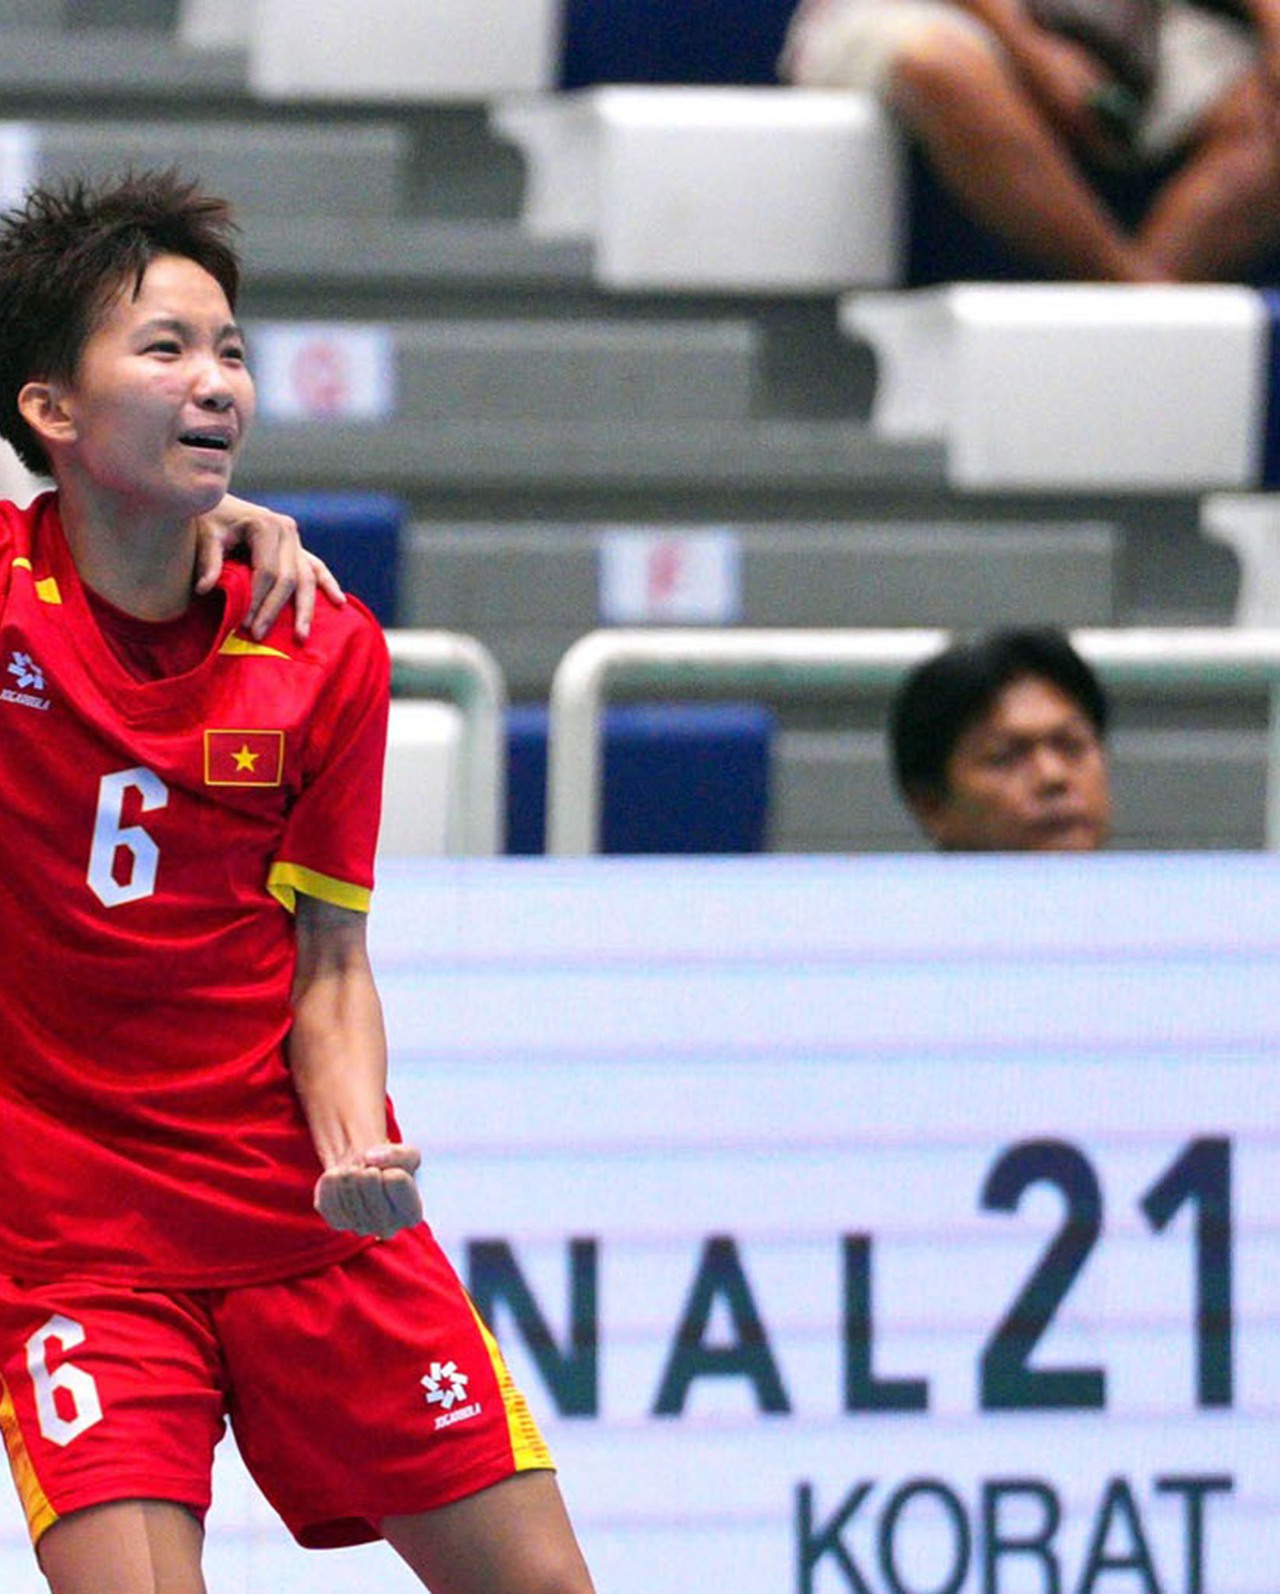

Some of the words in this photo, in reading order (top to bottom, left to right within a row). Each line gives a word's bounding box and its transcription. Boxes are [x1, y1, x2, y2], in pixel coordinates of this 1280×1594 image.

[86, 766, 169, 908] 6
[979, 1134, 1234, 1412] 21
[24, 1314, 103, 1447] 6
[794, 1473, 1235, 1594] KORAT
